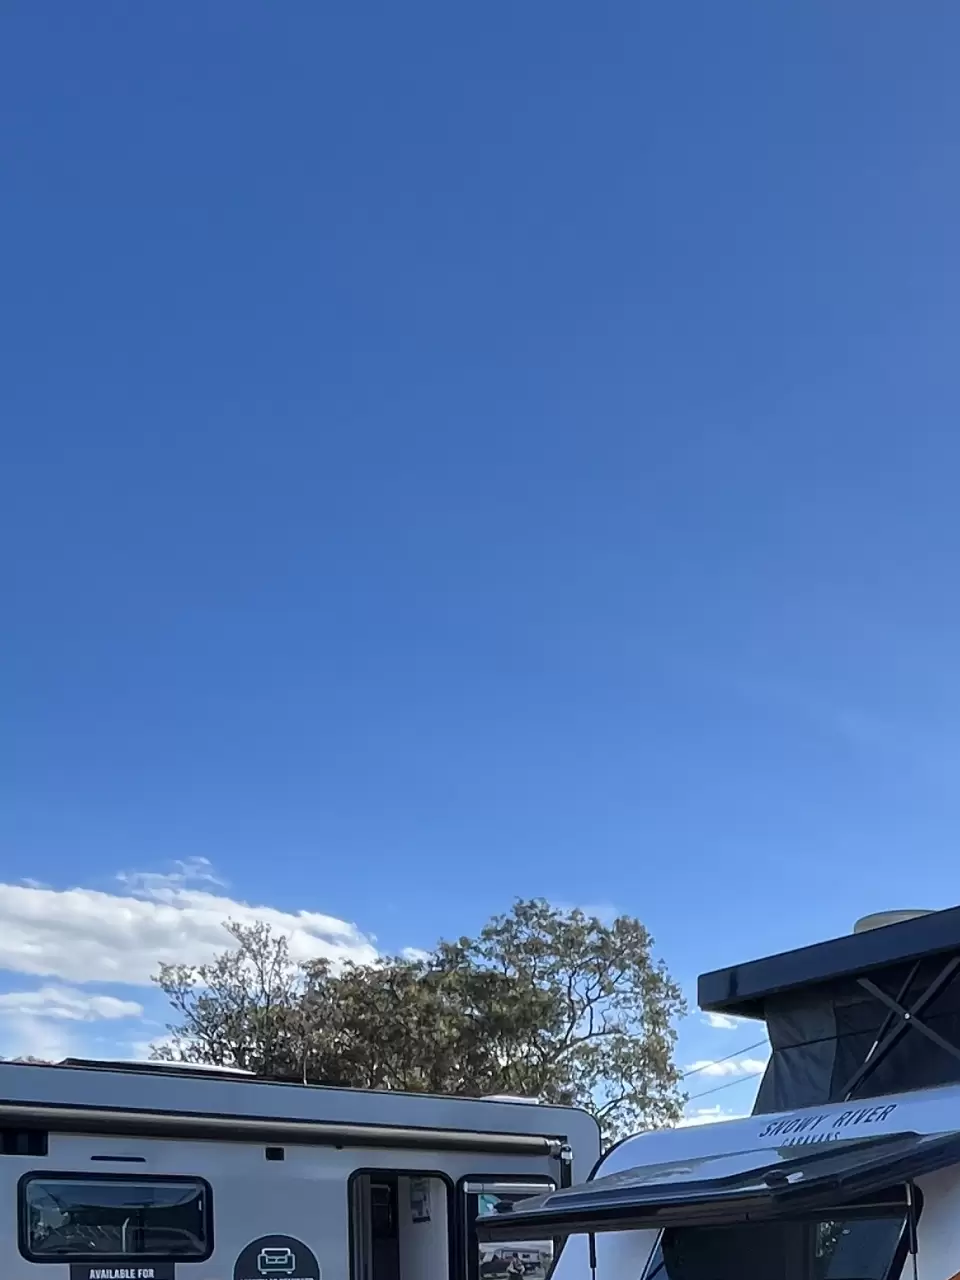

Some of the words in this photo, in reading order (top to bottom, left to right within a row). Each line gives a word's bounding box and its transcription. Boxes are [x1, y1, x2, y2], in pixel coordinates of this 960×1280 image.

[758, 1114, 832, 1138] SNOWY
[832, 1104, 898, 1129] RIVER
[89, 1268, 136, 1279] AVAILABLE
[138, 1268, 155, 1279] FOR
